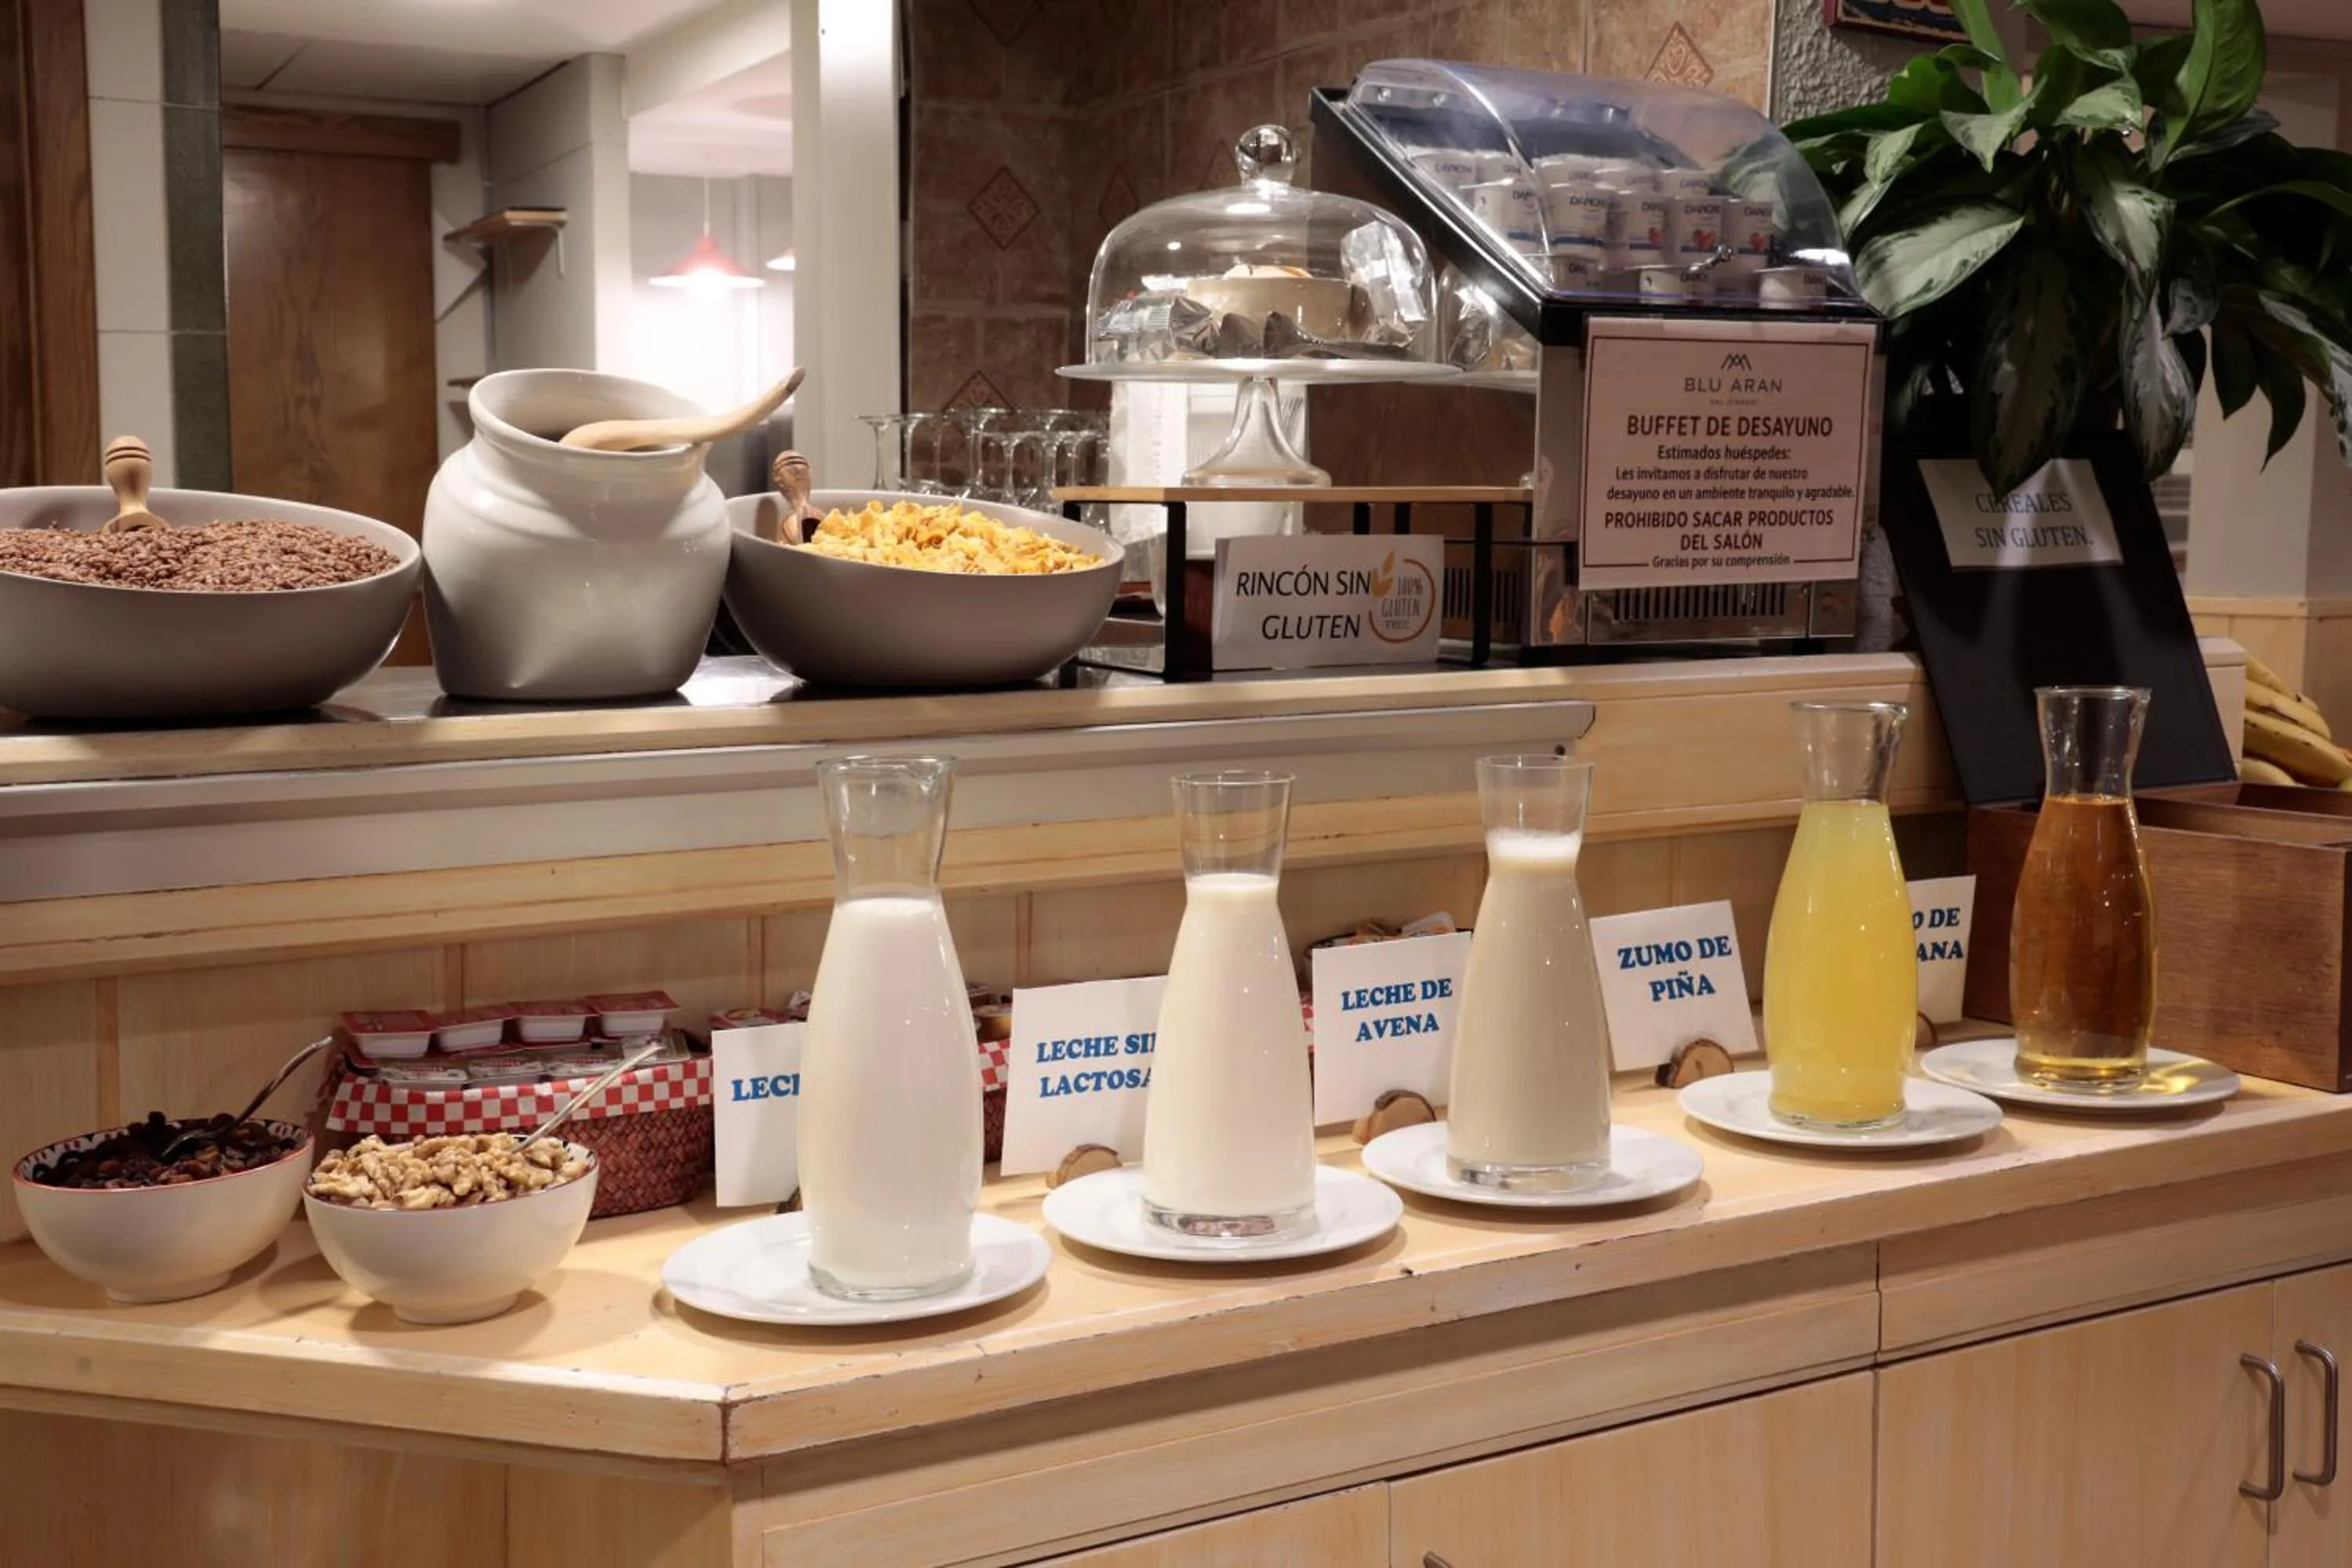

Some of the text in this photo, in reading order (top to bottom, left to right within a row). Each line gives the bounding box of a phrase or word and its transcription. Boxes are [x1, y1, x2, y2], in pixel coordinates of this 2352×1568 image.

[1434, 162, 1472, 174] DANON
[1684, 377, 1783, 393] BLU ARAN
[1627, 415, 1833, 437] BUFFET DE DESAYUNO
[1657, 444, 1791, 463] Estimados huéspedes:
[1616, 466, 1808, 481] Les invitamos a disfrutar de nuestro
[1606, 484, 1855, 503] desayuno en un ambiente tranquilo y agradable.
[1605, 510, 1835, 528] PROHIBIDO SACAR PRODUCTOS
[1680, 528, 1763, 550] DEL SALÓN
[1975, 526, 2093, 547] SIN GLUTEN.
[1652, 552, 1790, 571] Gracias por su comprensión
[1236, 564, 1371, 597] RINCÓN SIN
[1261, 614, 1361, 640] GLUTEN
[1911, 907, 1961, 930] O DE
[1617, 935, 1733, 970] ZUMO DE
[1916, 940, 1964, 962] ANA
[1341, 978, 1453, 1011] LECHE DE
[1650, 971, 1717, 1003] PIÑA
[1355, 1012, 1440, 1043] AVENA
[1036, 1035, 1119, 1063] LECHE
